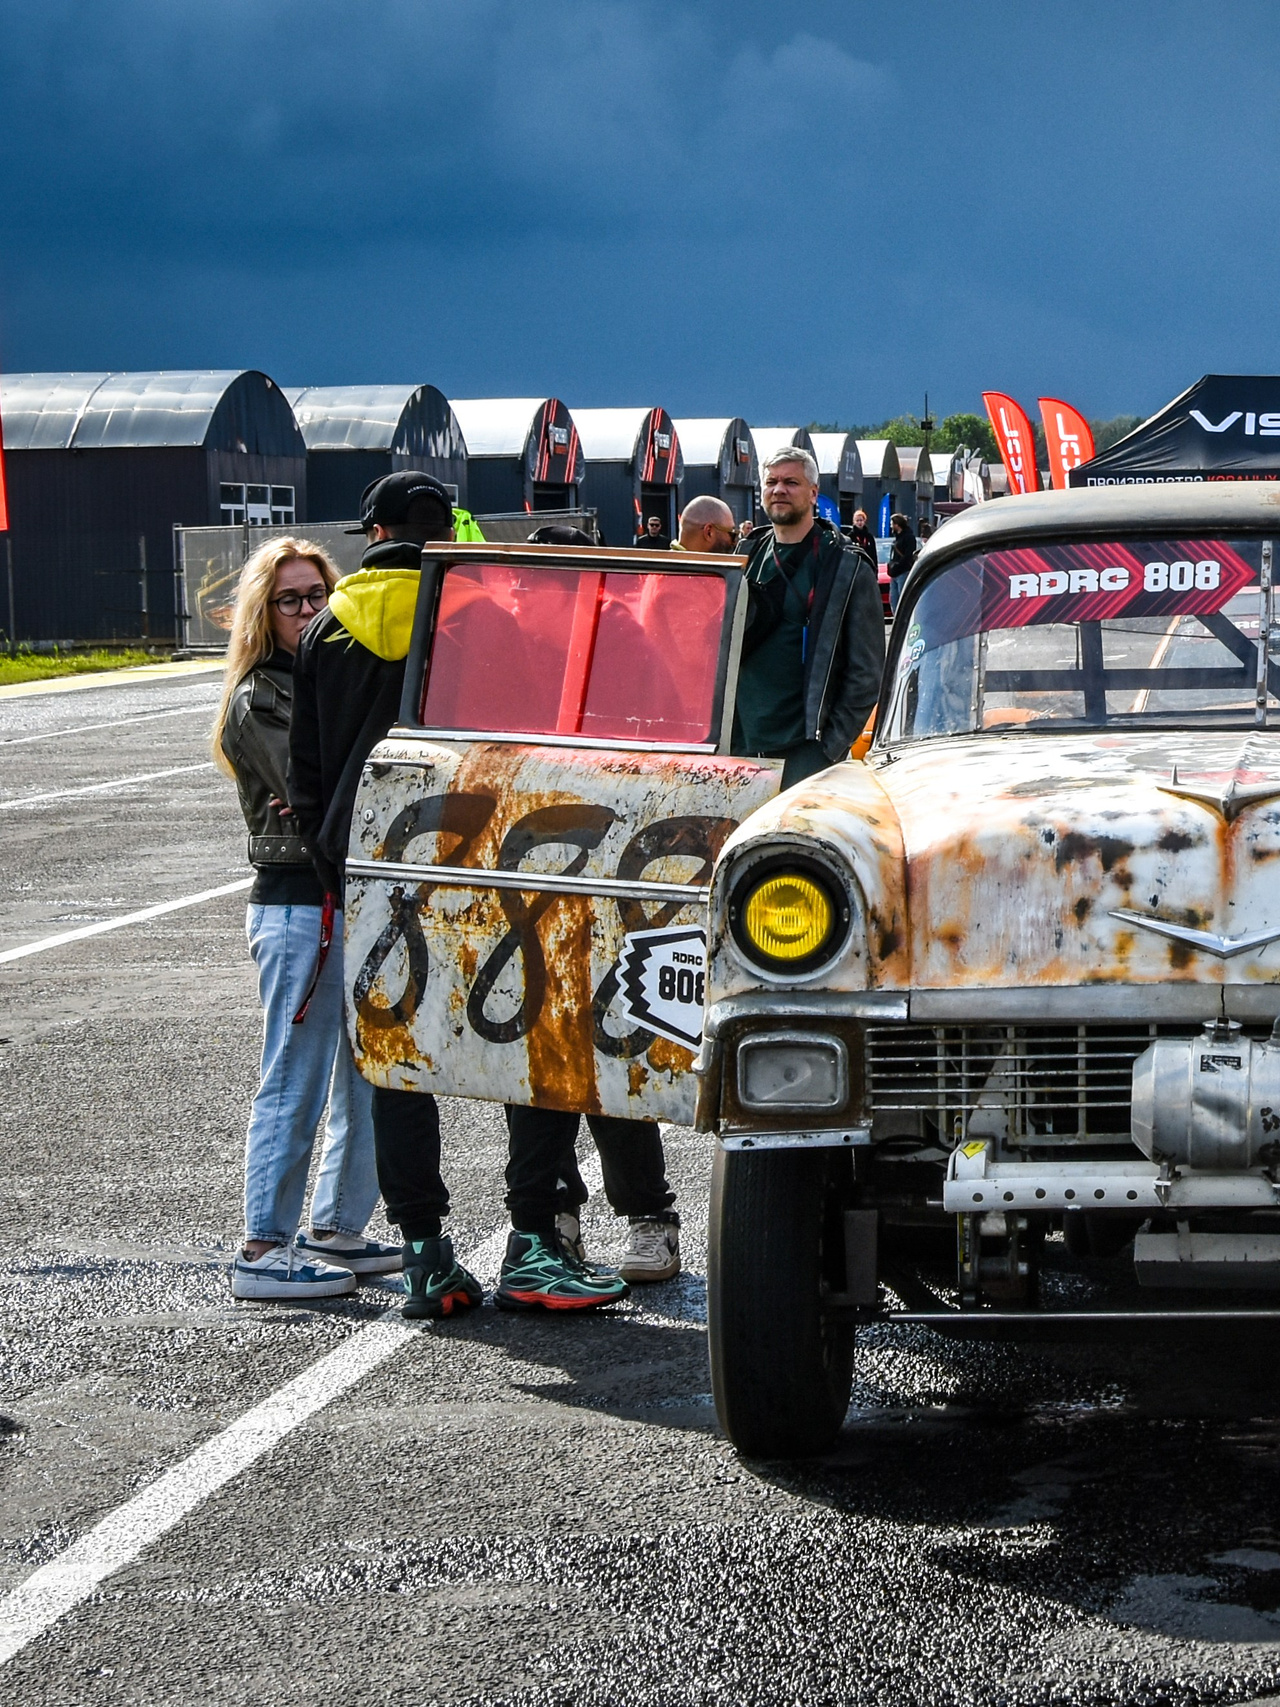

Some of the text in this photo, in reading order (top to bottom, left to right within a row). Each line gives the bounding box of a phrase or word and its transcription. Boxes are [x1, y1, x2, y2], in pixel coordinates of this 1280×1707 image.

[1008, 560, 1221, 599] RDRC 808
[672, 952, 703, 966] RDRC
